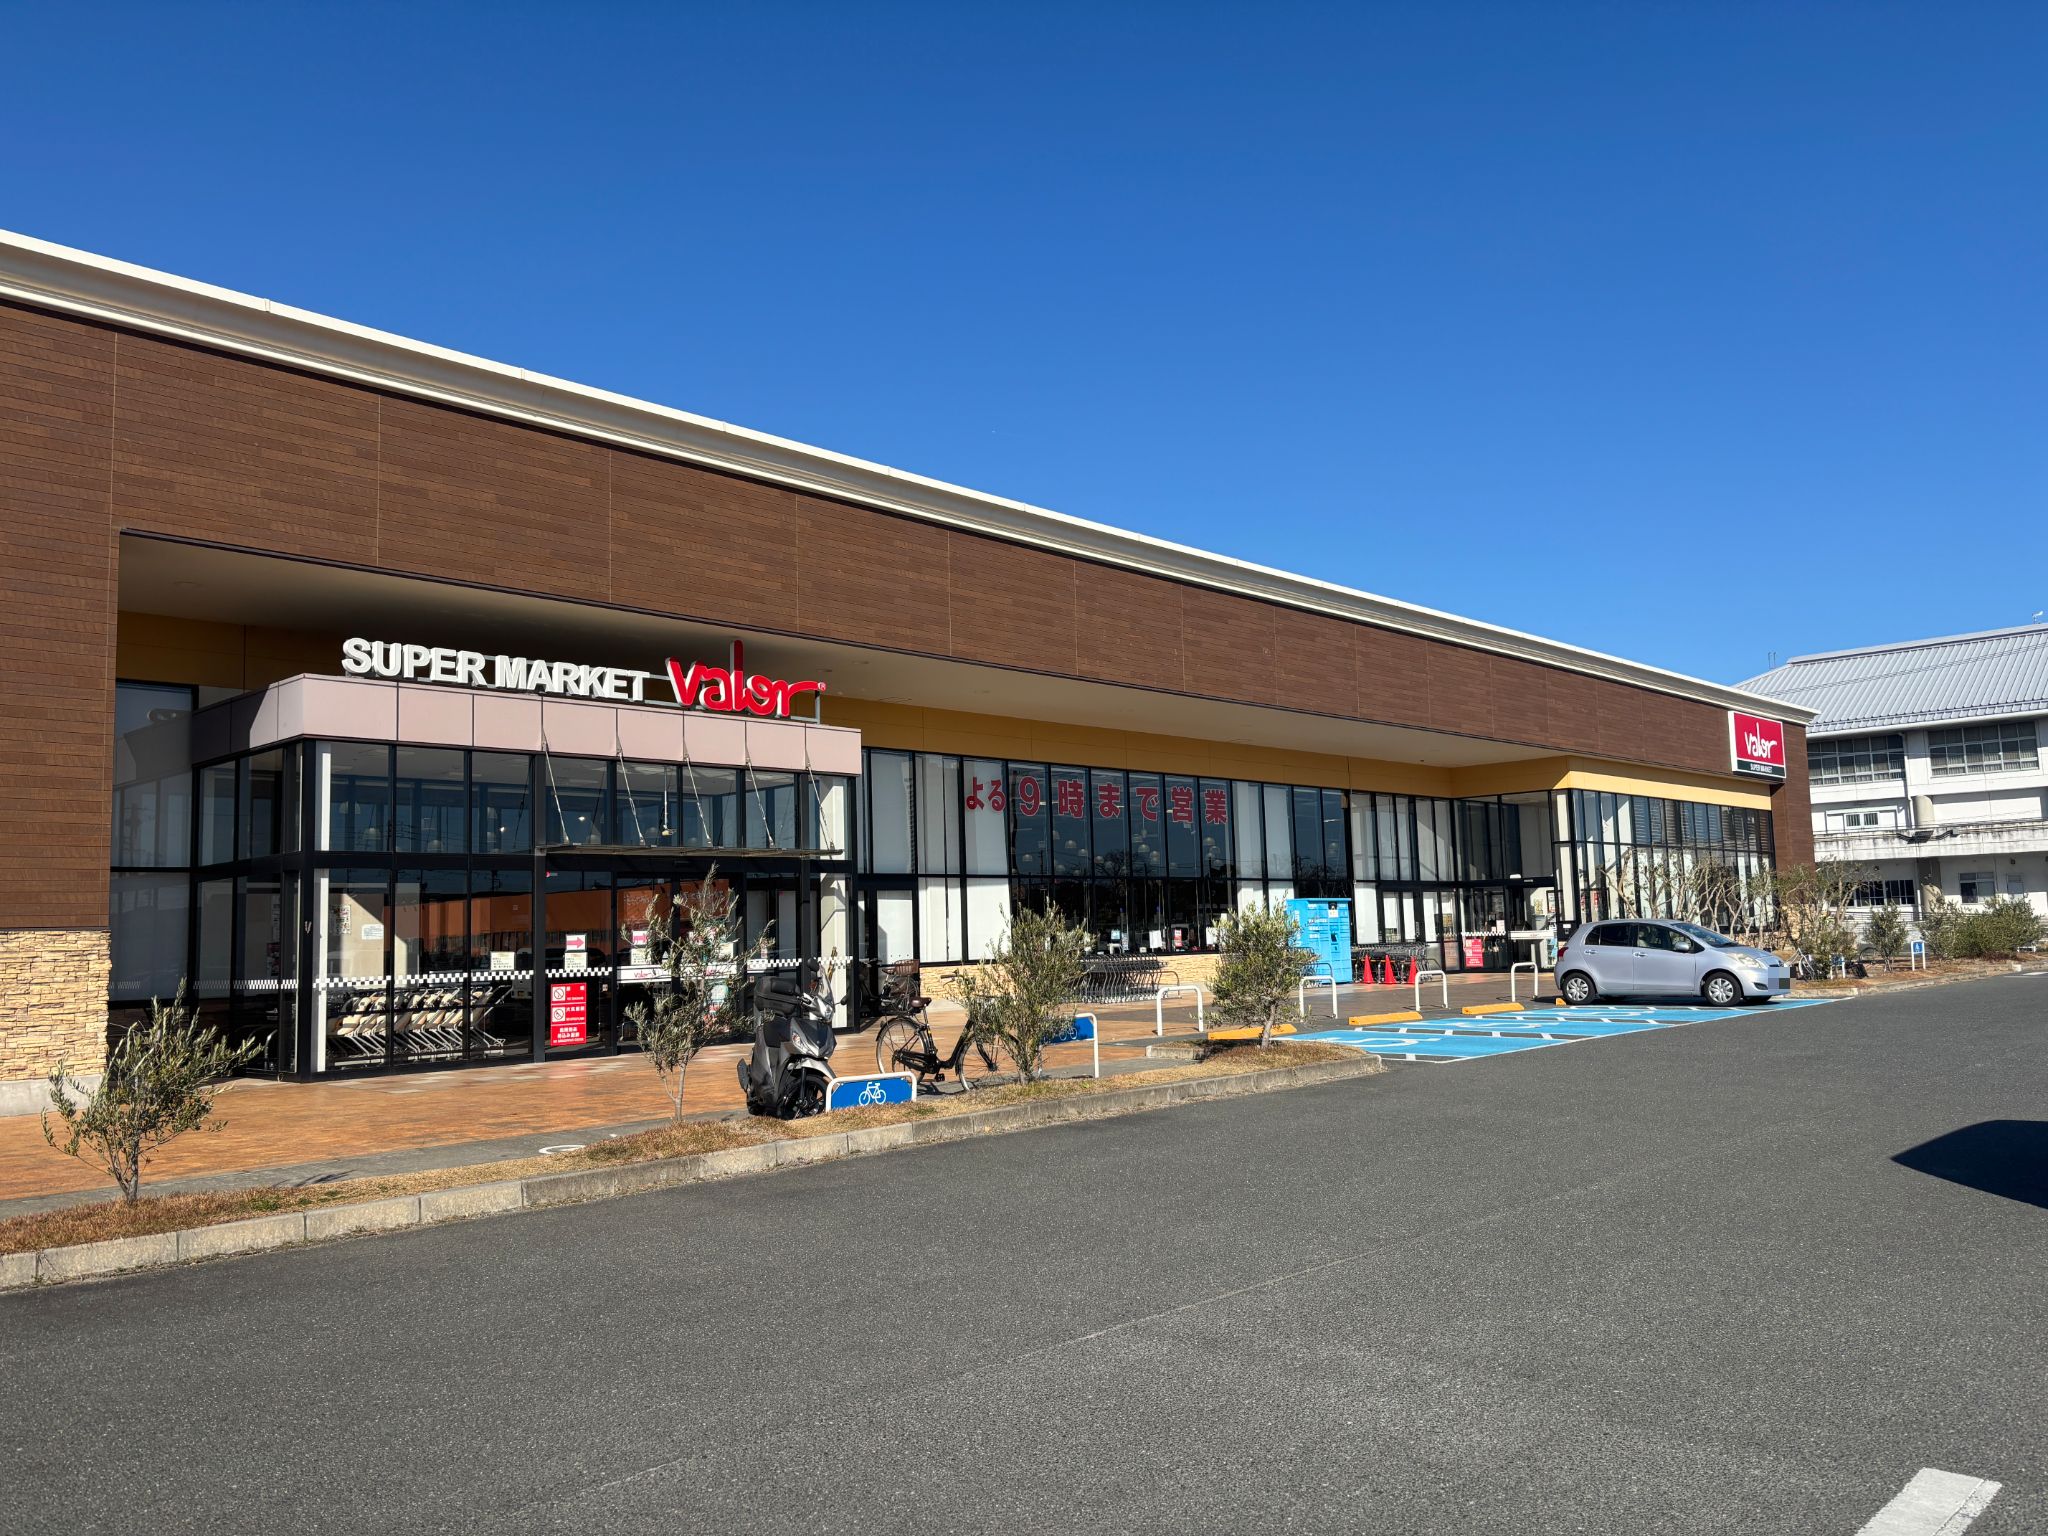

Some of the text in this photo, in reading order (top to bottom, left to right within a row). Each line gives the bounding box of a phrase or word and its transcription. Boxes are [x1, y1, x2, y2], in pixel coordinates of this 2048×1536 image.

[341, 637, 650, 701] SUPER MARKET
[965, 776, 1228, 825] よる9時まで営業
